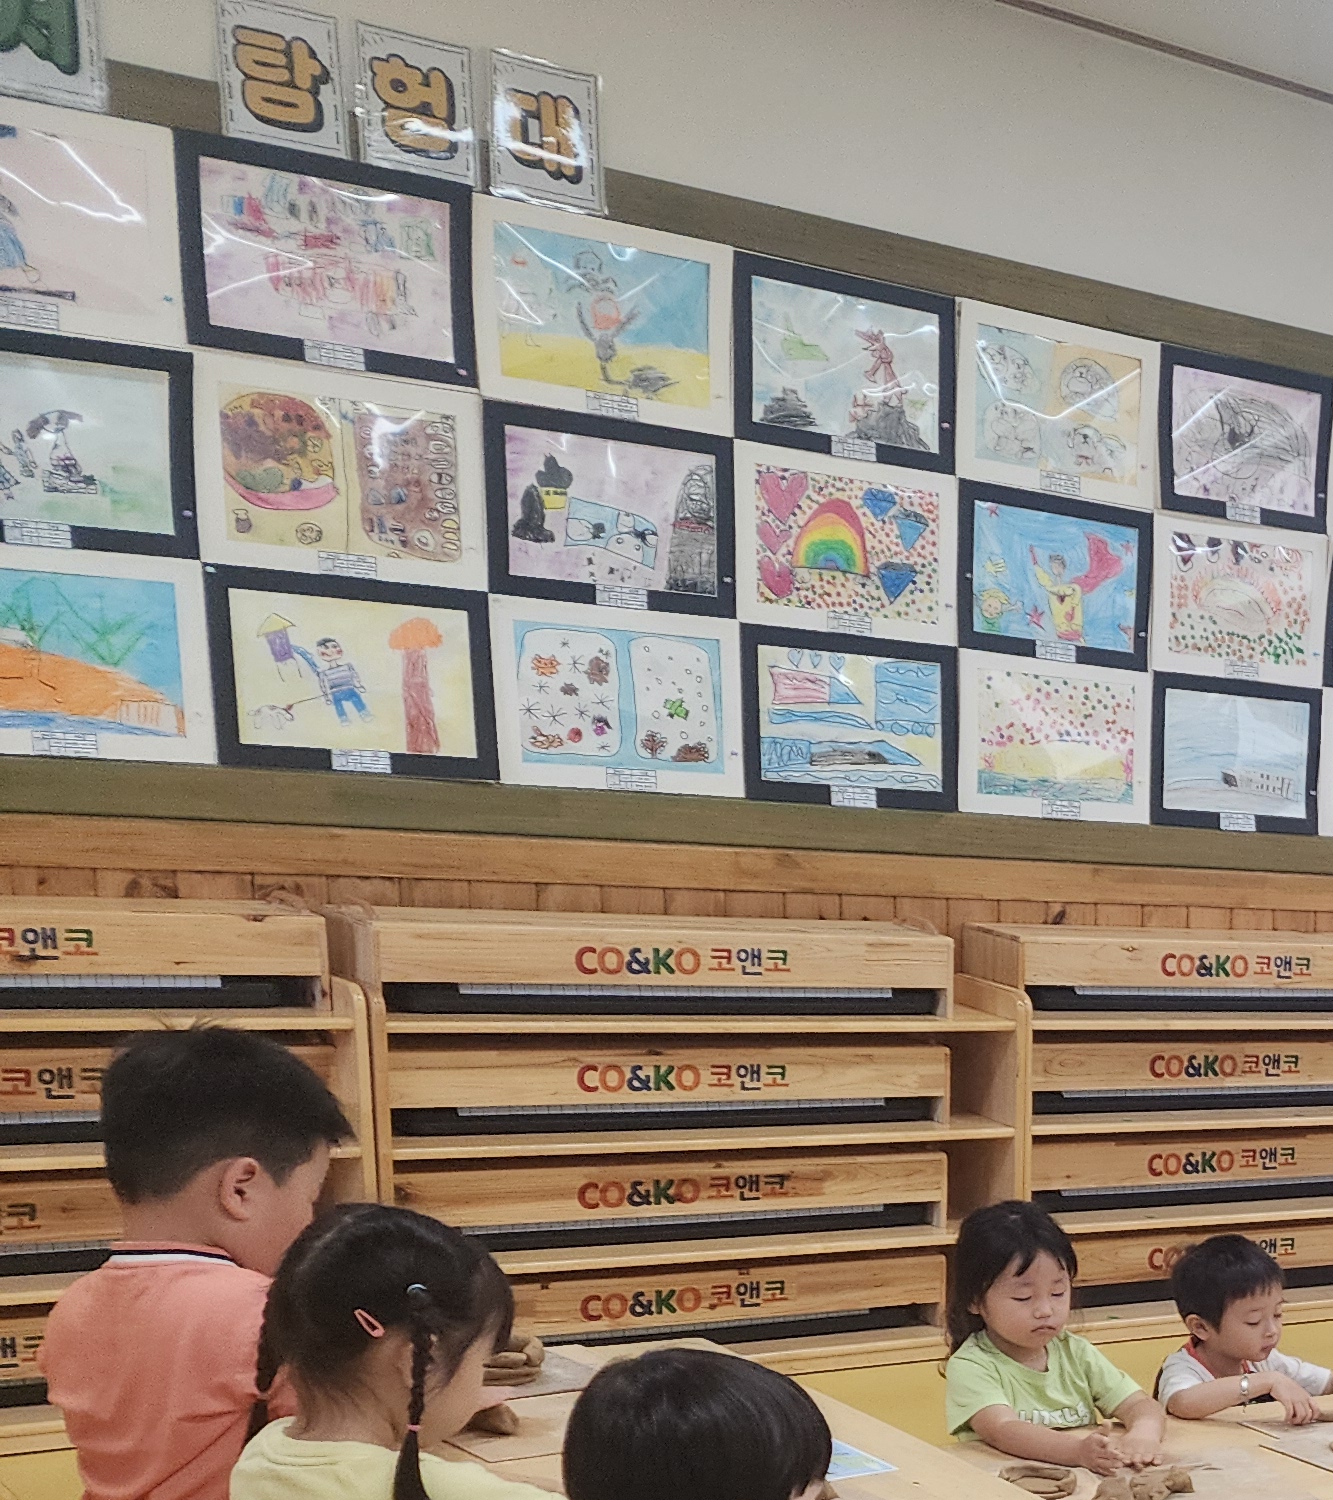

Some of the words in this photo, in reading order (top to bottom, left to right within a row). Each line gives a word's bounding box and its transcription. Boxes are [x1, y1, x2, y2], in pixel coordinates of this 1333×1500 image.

[575, 946, 700, 975] CO&KO
[708, 947, 791, 976] 코앤코
[1161, 953, 1249, 977] CO&KO
[1253, 955, 1312, 979] 코앤코
[576, 1064, 700, 1092] CO&KO
[708, 1063, 790, 1091] 코앤코
[1150, 1054, 1237, 1078] CO&KO
[1241, 1053, 1300, 1077] 코앤코
[1147, 1150, 1235, 1177] CO&KO
[1239, 1147, 1297, 1170] 코앤코
[577, 1178, 700, 1209] CO&KO
[707, 1174, 788, 1202] 코앤코
[580, 1286, 702, 1322] CO&KO
[707, 1280, 789, 1308] 코앤코
